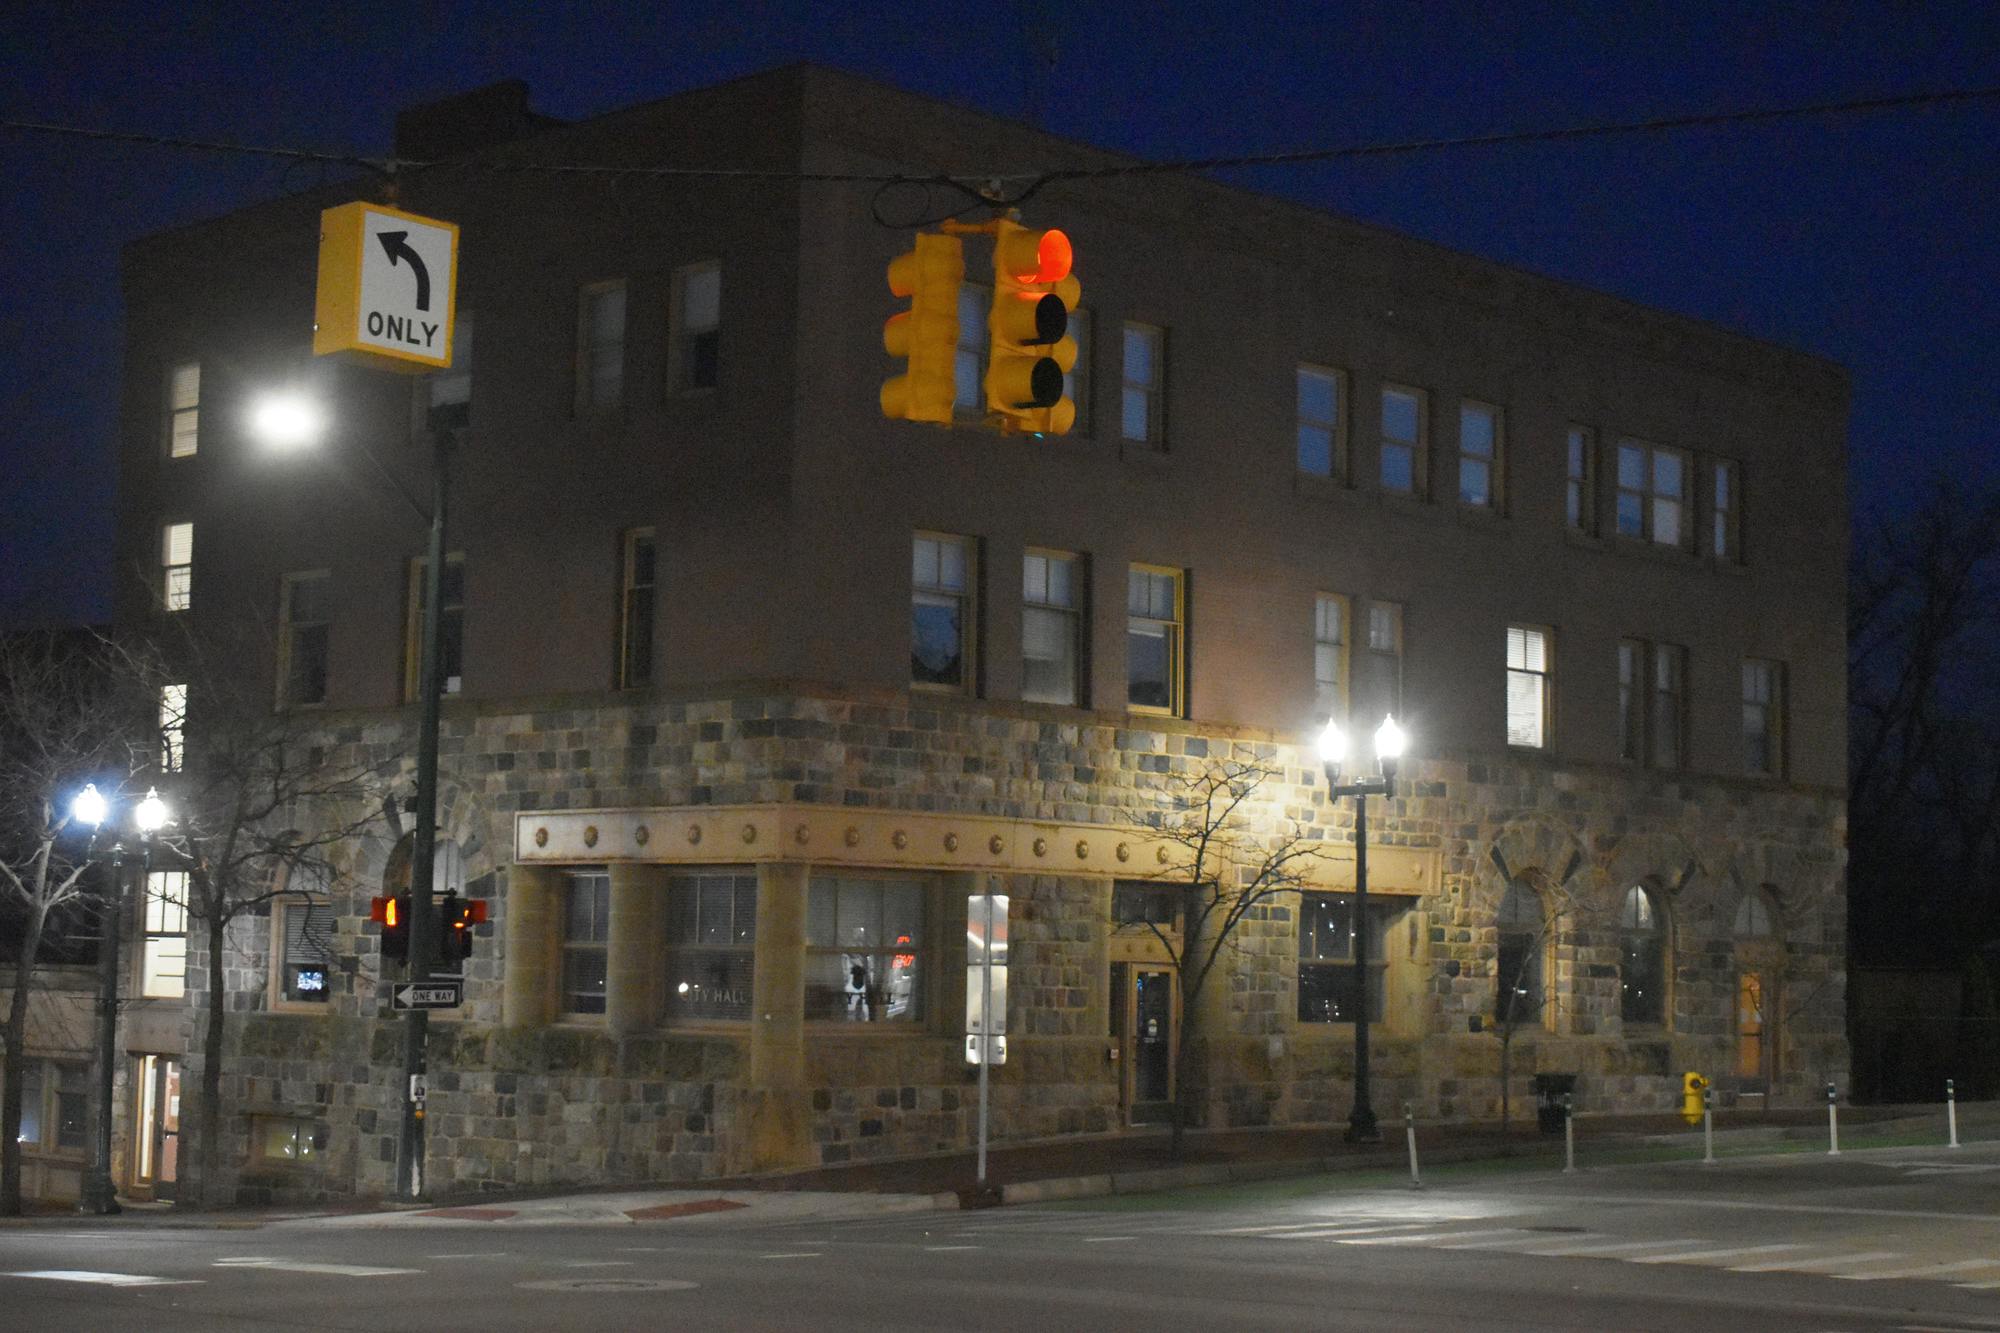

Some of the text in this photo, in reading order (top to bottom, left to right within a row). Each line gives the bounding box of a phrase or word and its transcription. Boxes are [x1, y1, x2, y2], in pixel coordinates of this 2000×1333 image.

[368, 311, 438, 347] ONLY
[412, 991, 453, 1001] ONE WAY
[714, 989, 746, 1004] HALL
